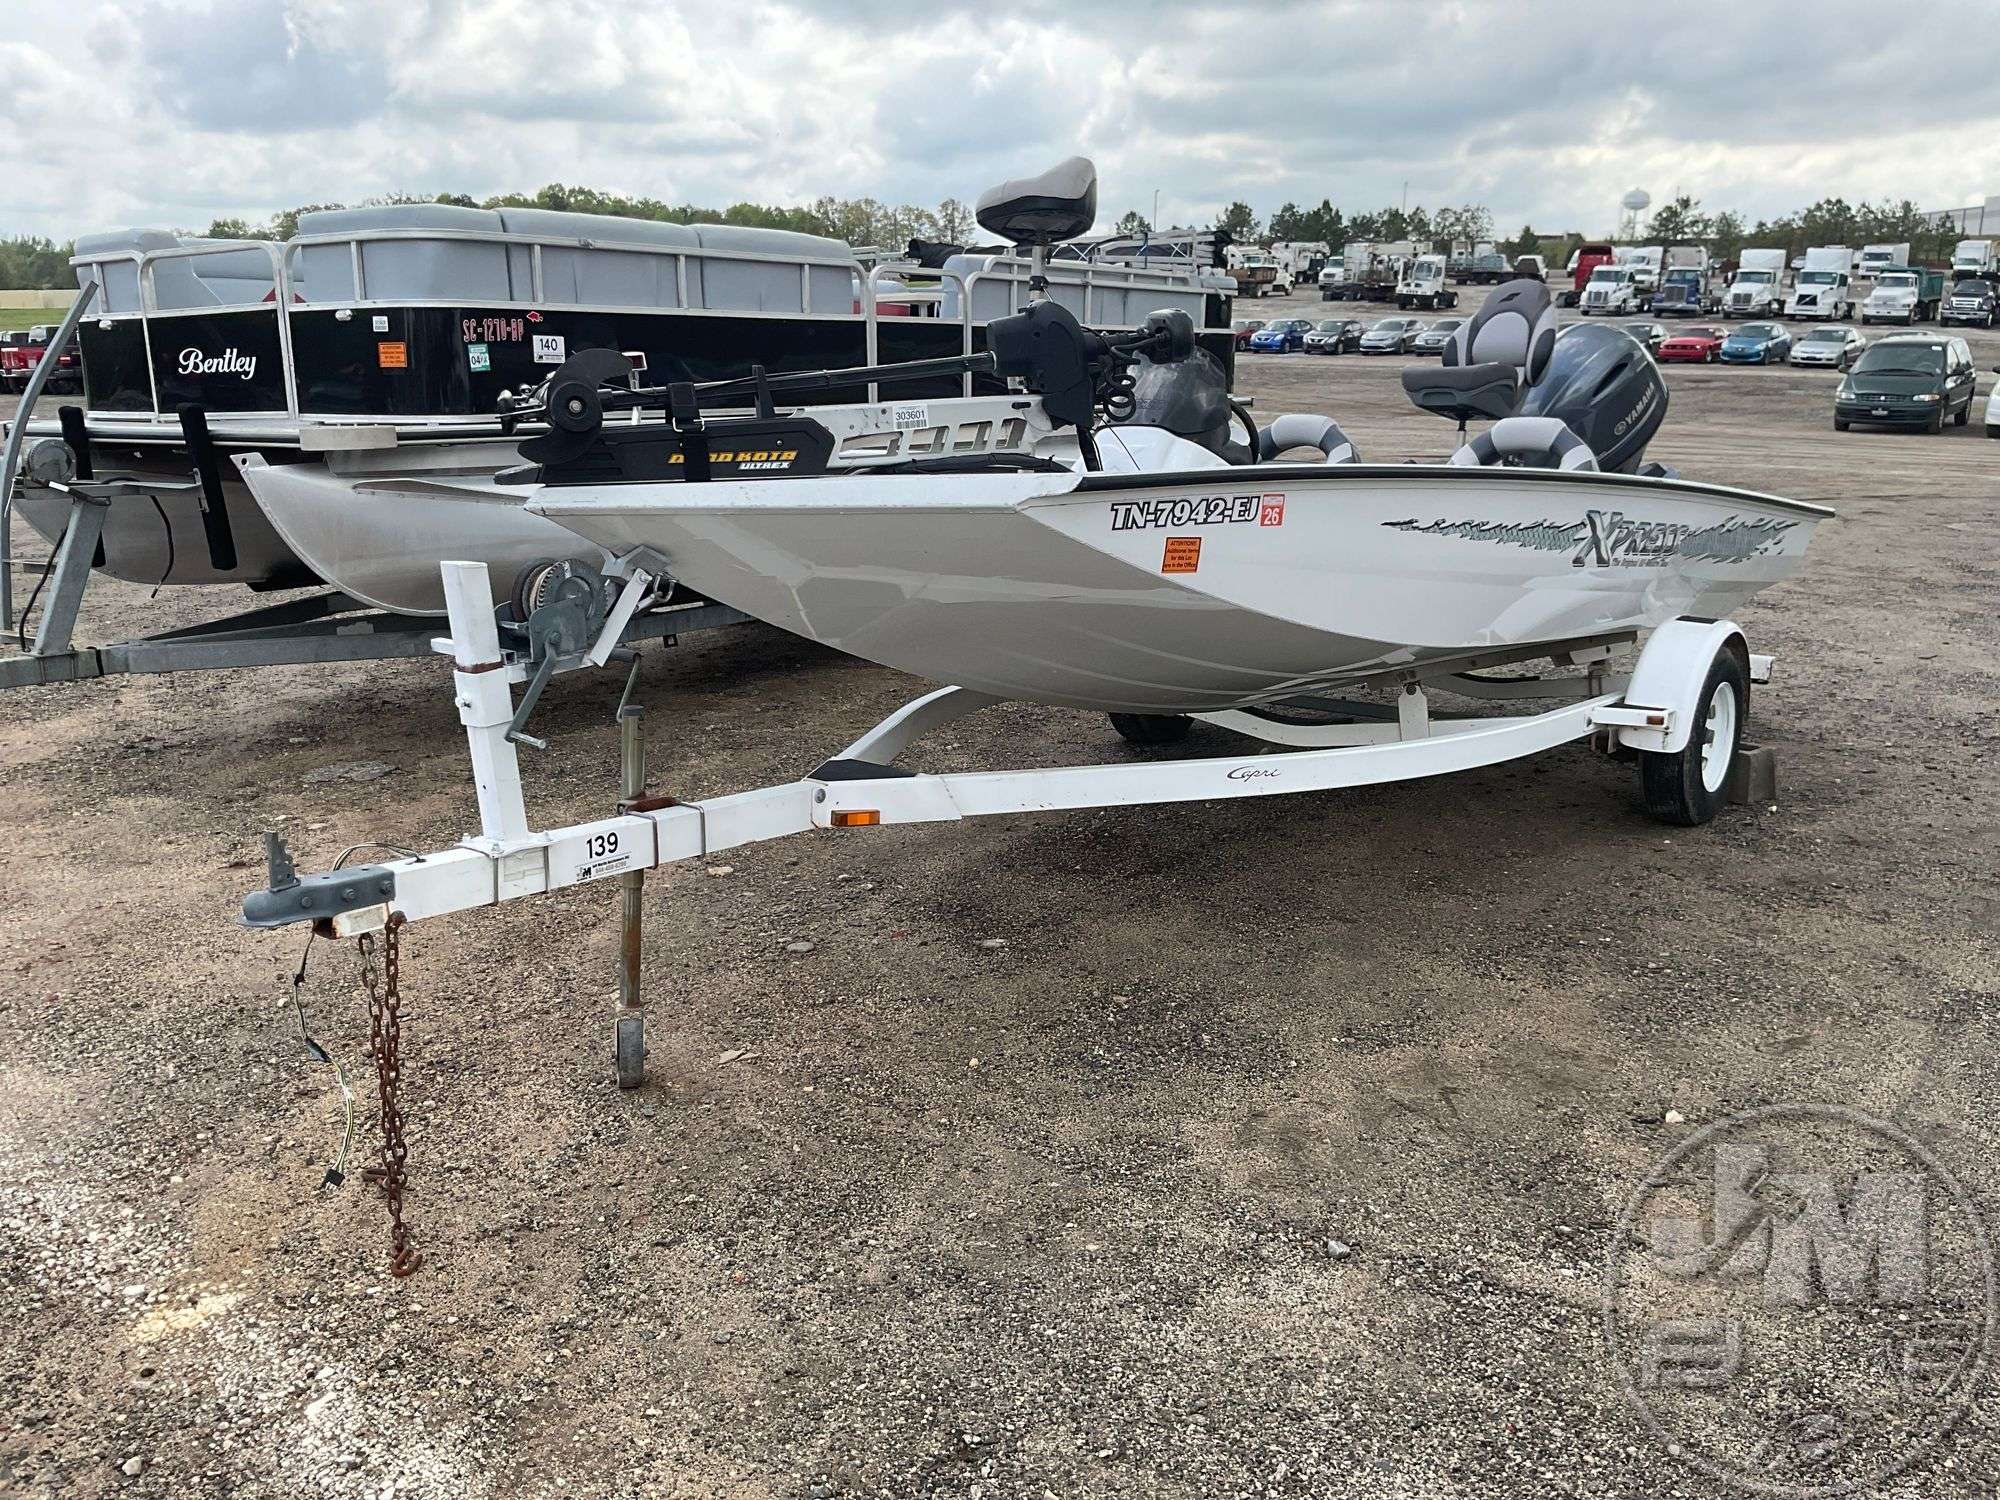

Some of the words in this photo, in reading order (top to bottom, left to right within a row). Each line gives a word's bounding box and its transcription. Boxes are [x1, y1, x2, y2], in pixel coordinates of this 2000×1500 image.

[540, 338, 558, 351] 140
[178, 347, 257, 380] Bentley
[895, 409, 925, 421] 303601
[735, 450, 798, 462] KOTA
[738, 461, 792, 470] ULTREX
[1112, 496, 1261, 530] TN-7942-EJ
[1263, 507, 1279, 525] 26
[1227, 765, 1281, 783] Capri
[587, 832, 618, 859] 139
